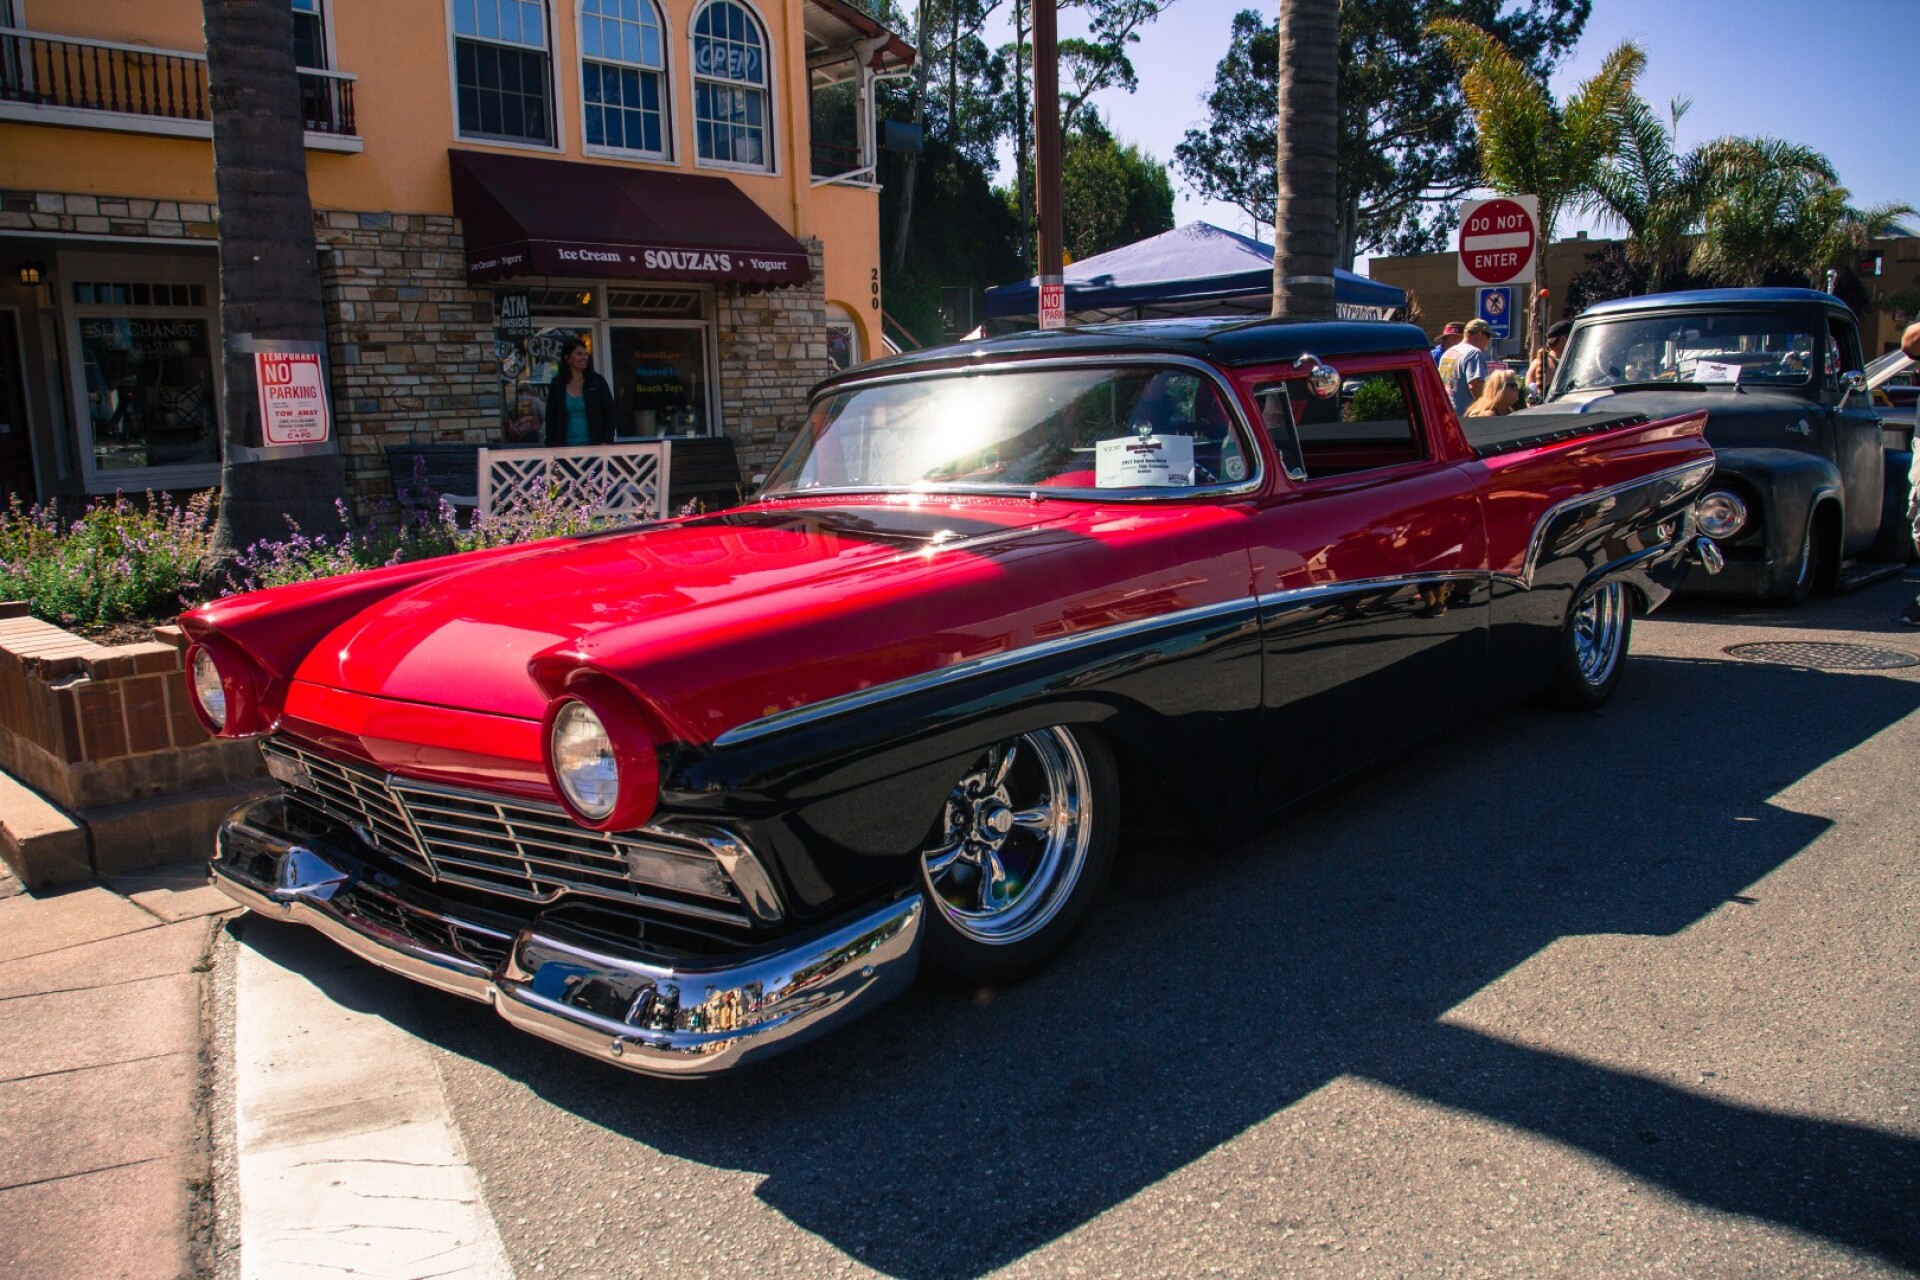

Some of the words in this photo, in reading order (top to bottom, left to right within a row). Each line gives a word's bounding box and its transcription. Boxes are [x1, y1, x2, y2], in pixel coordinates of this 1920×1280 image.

[700, 44, 751, 73] OPEN
[1471, 217, 1490, 232] DO
[1497, 214, 1524, 229] NOT
[558, 249, 578, 260] Ice
[579, 250, 622, 262] Cream
[644, 250, 732, 272] SOUZA'S
[750, 258, 788, 272] Yogurt
[1475, 253, 1517, 268] ENTER
[871, 267, 879, 310] 200
[501, 295, 528, 317] ATM
[1043, 293, 1059, 308] NO
[130, 323, 198, 338] CHANGE
[501, 317, 530, 328] INSIDE
[264, 363, 290, 383] NO
[269, 385, 317, 400] PARKING
